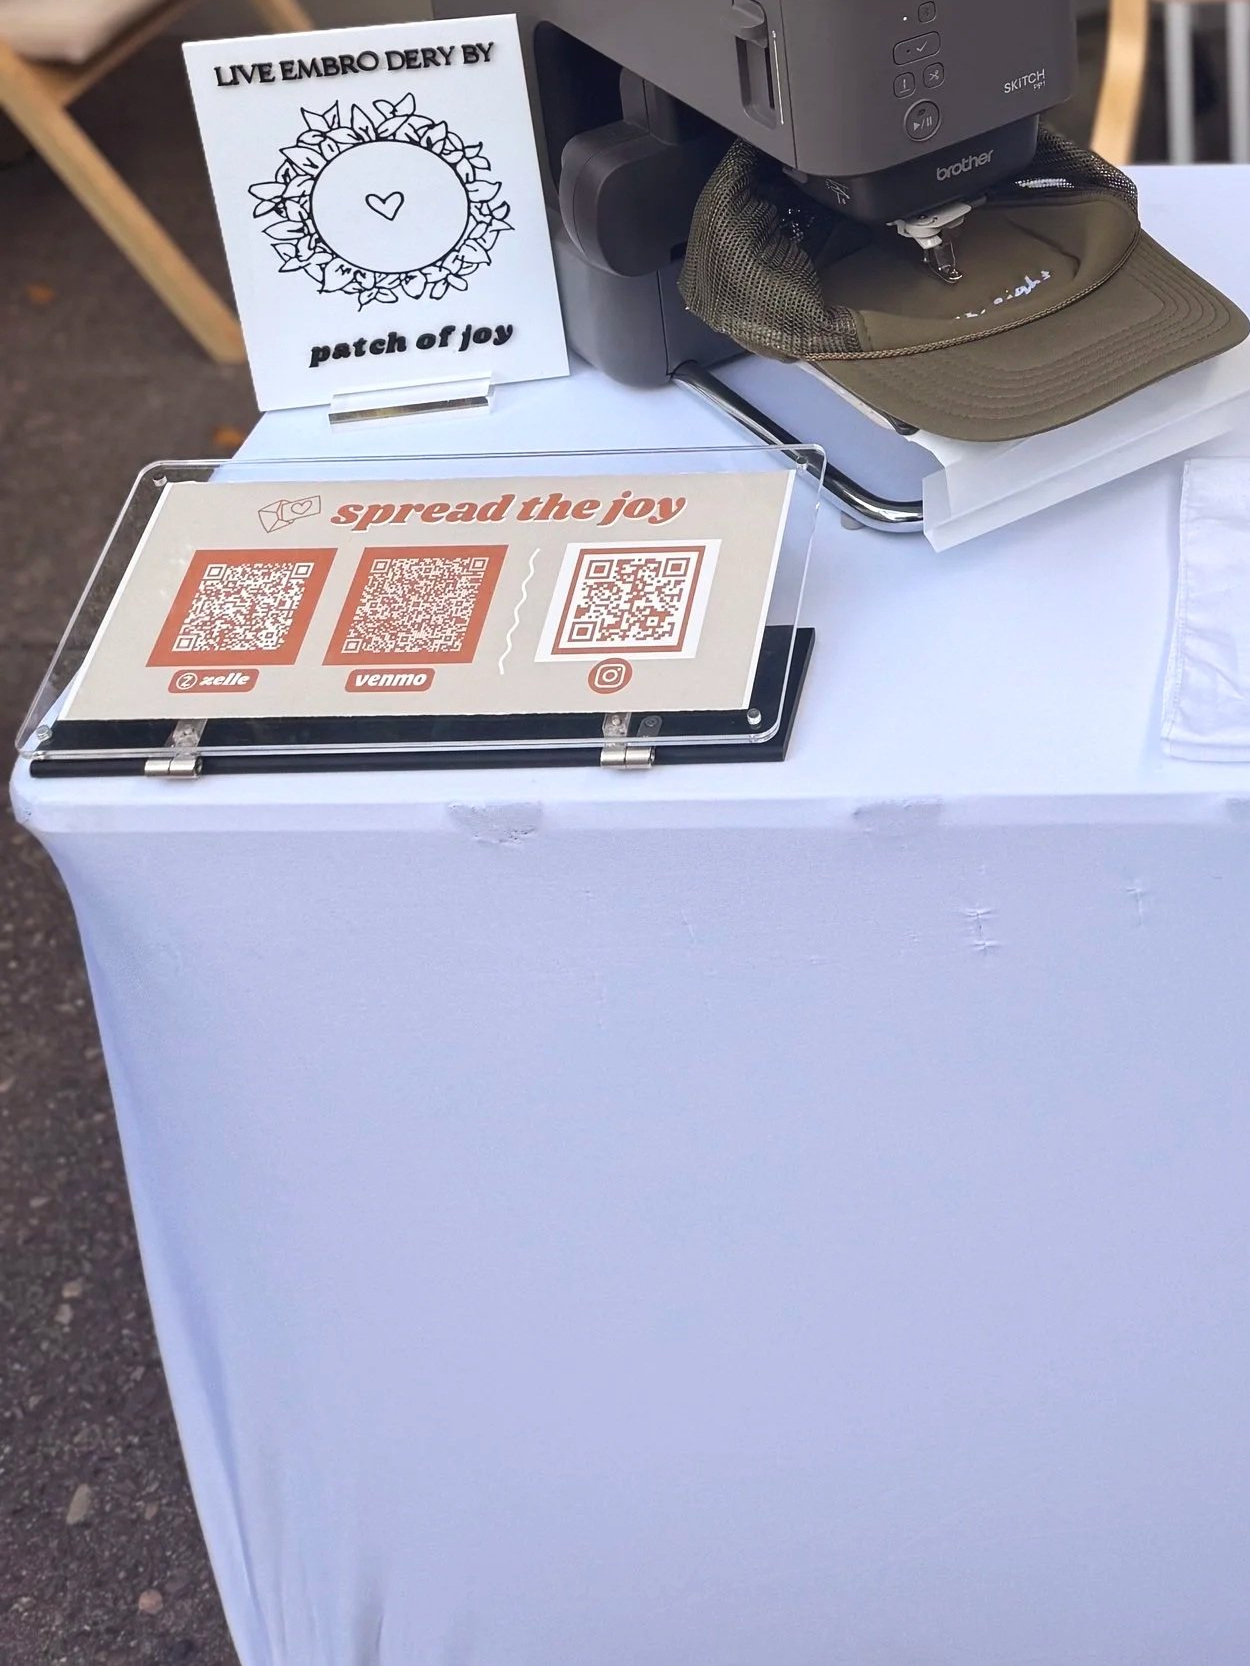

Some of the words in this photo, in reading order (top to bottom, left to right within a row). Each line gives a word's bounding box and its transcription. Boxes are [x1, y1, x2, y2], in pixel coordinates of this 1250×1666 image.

[214, 62, 276, 86] LIVE
[461, 42, 494, 64] BY
[936, 149, 994, 181] brother
[309, 331, 407, 368] patch
[415, 325, 456, 350] of
[458, 324, 513, 351] joy
[330, 494, 516, 532] spread
[516, 493, 602, 522] the
[596, 490, 687, 527] joy
[199, 672, 251, 686] zelle
[355, 672, 427, 687] venmo
